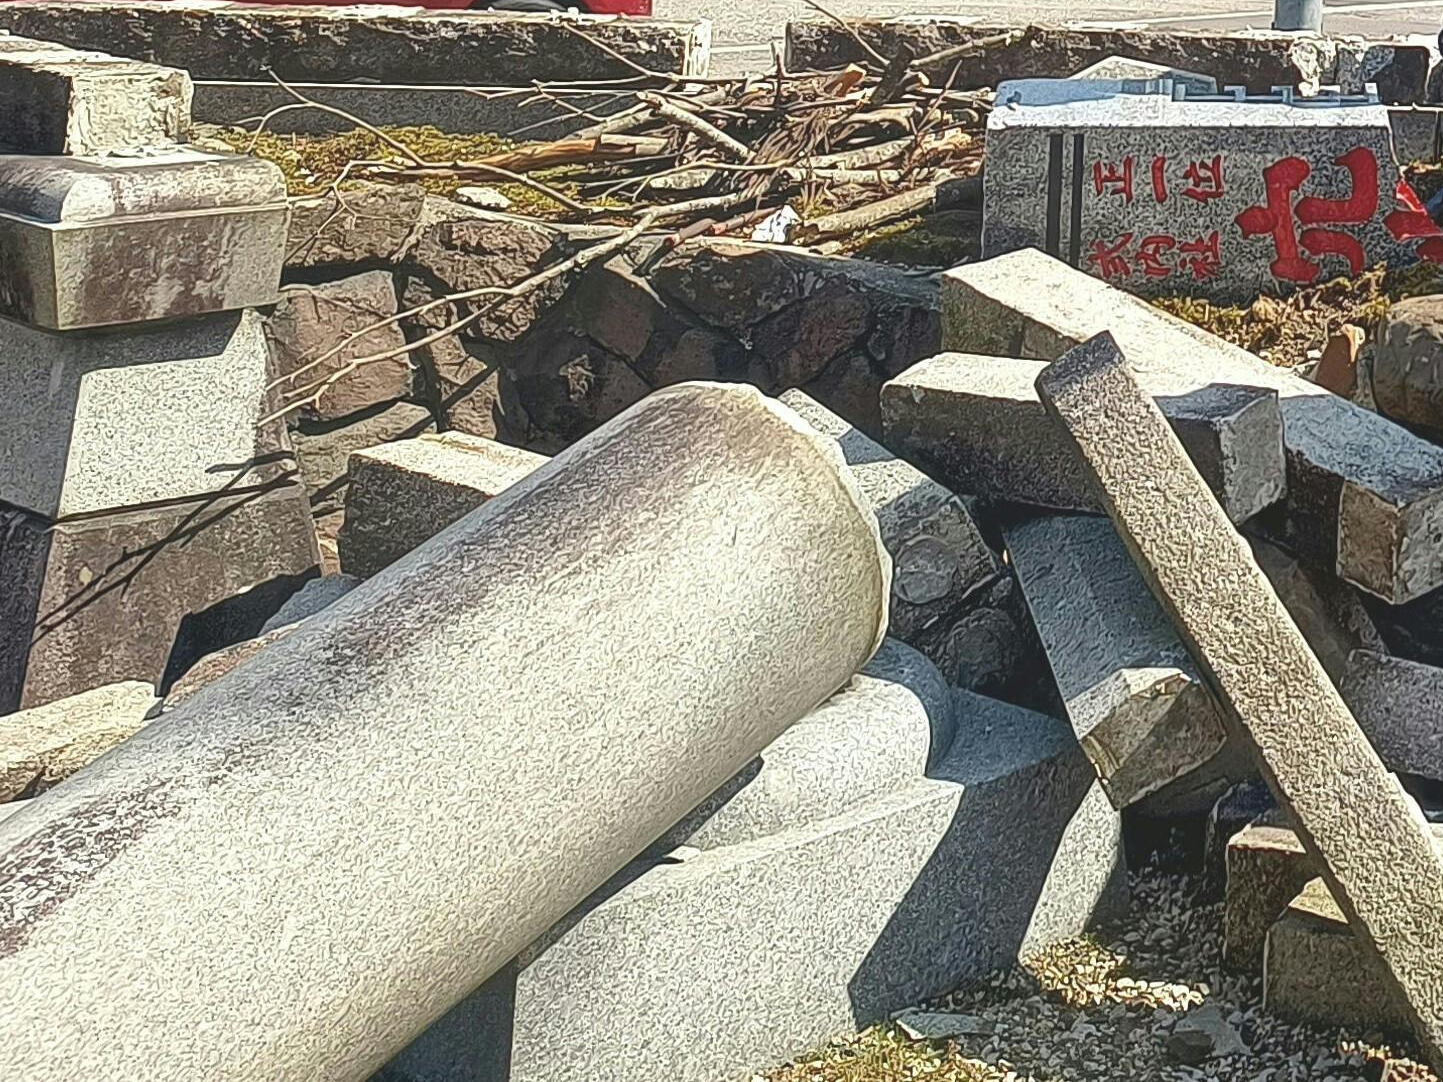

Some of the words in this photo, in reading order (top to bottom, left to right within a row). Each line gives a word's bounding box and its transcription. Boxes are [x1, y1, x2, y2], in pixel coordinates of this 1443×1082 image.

[1093, 154, 1225, 205] 正一位
[1087, 230, 1222, 282] 式内社
